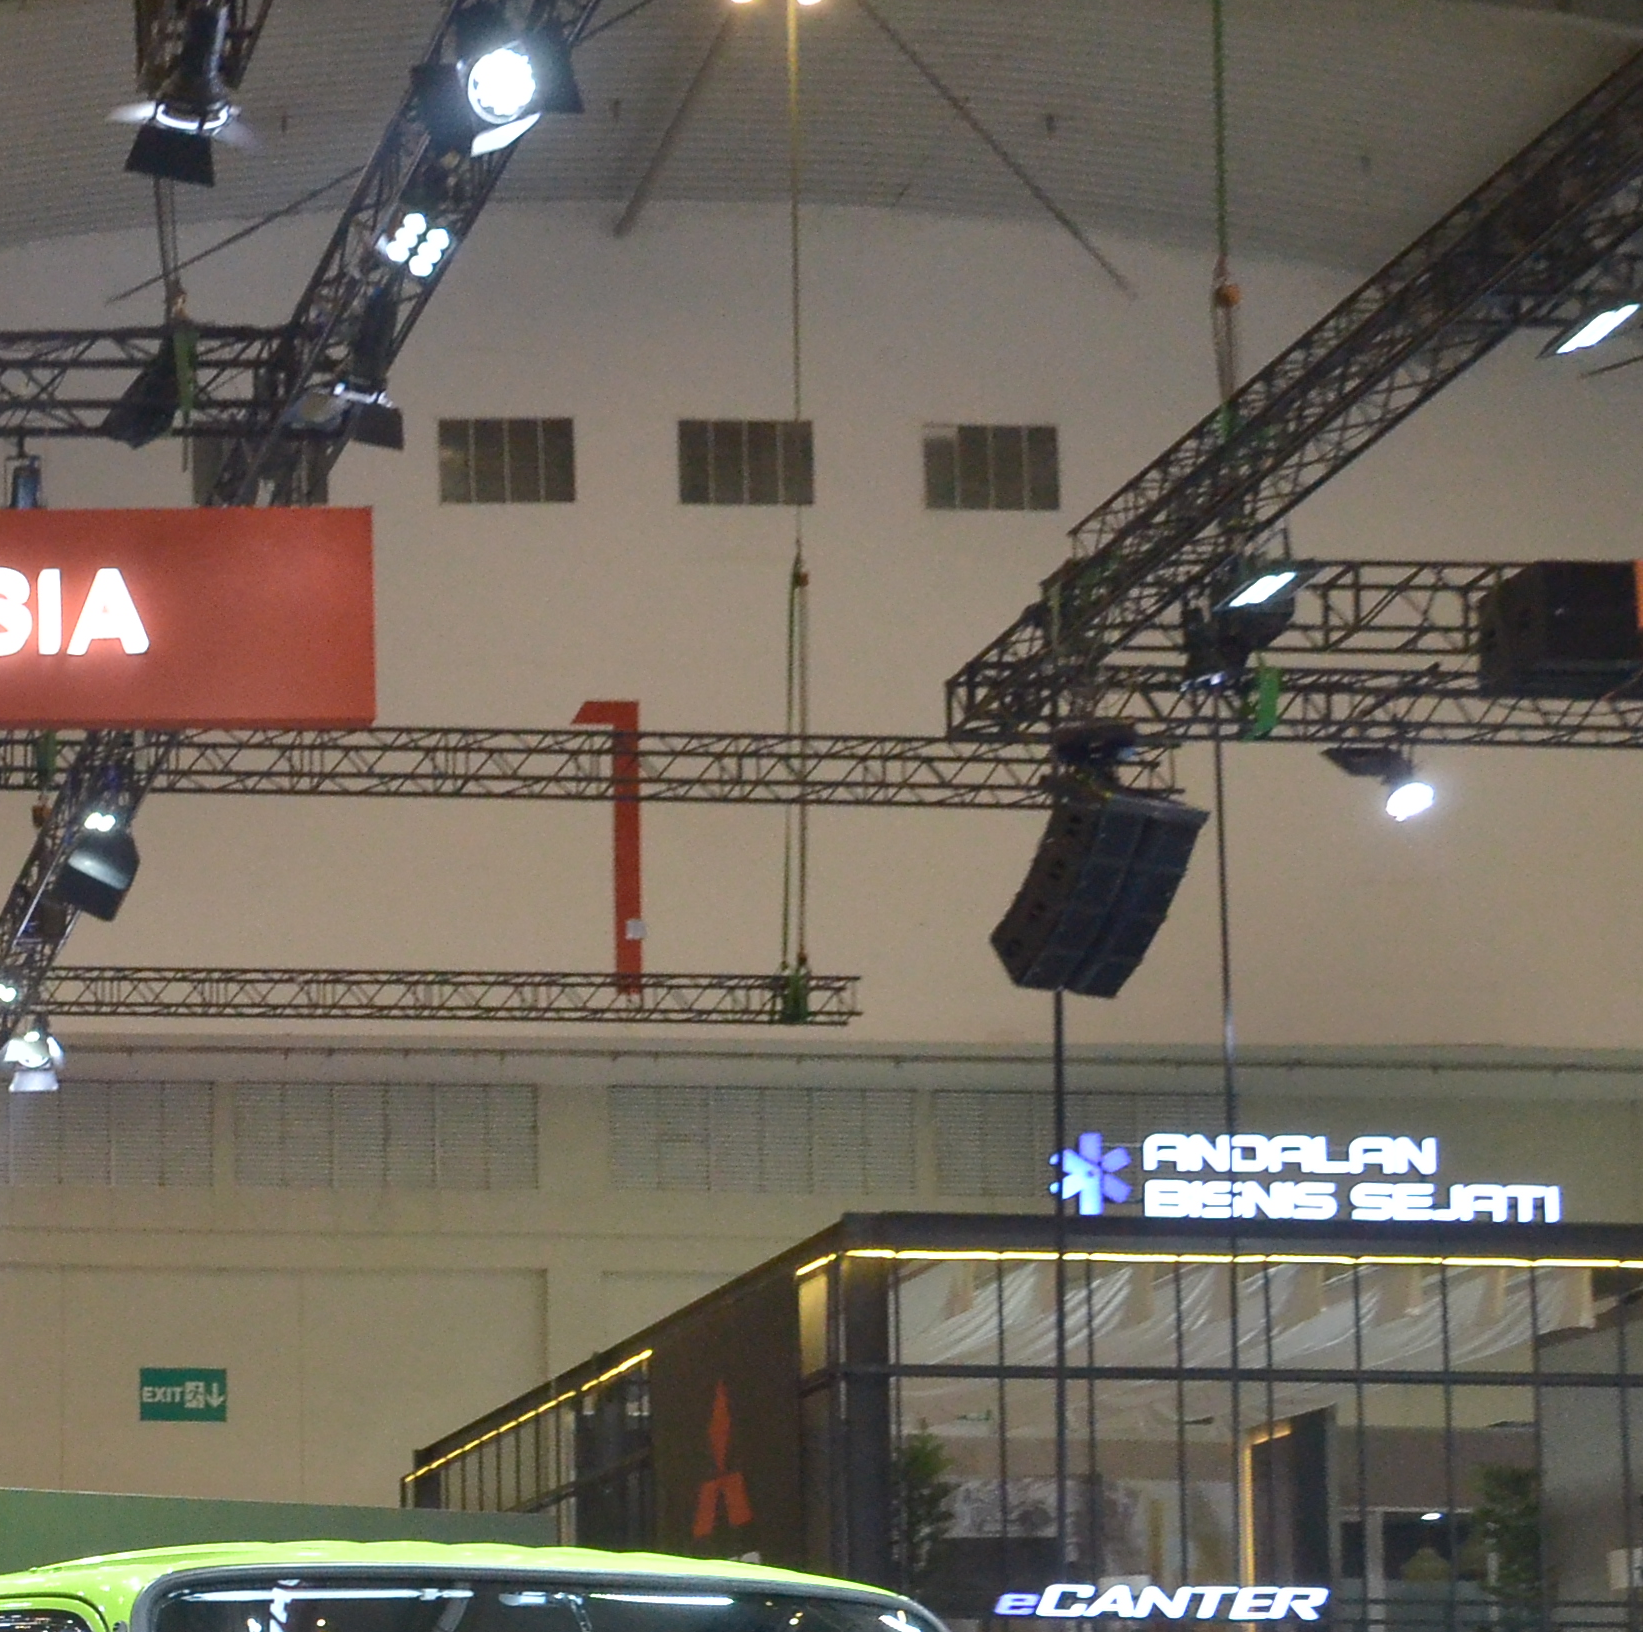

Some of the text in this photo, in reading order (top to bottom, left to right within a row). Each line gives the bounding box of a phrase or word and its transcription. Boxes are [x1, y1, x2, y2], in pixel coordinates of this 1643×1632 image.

[1142, 1133, 1439, 1175] ANDALAN
[1350, 1181, 1563, 1224] SEJATI
[142, 1386, 183, 1403] EXIT
[994, 1582, 1330, 1622] eCANTER
